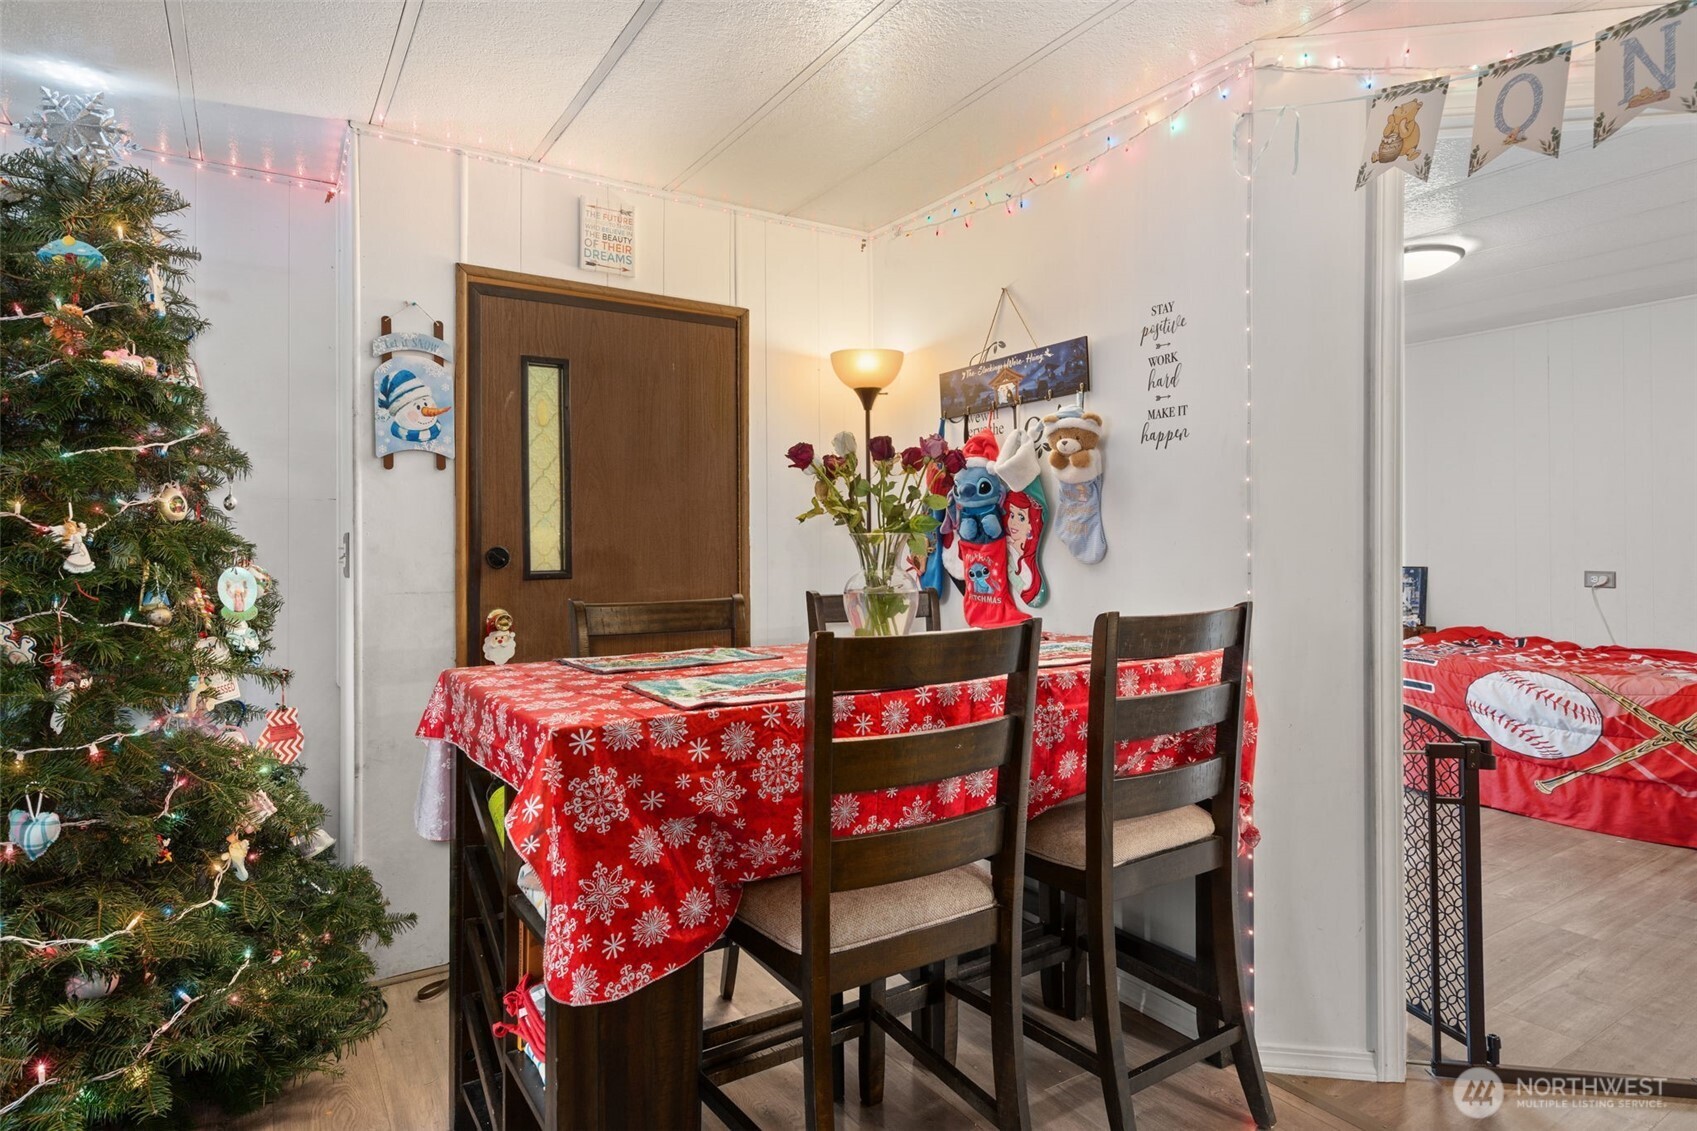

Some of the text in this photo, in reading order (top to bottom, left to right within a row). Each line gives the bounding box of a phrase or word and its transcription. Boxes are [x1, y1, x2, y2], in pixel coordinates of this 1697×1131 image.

[586, 210, 601, 220] THE
[602, 213, 633, 225] FUTURE
[585, 223, 600, 232] WHO
[585, 230, 633, 244] THE BEAUTY
[584, 238, 632, 254] OF THEIR
[584, 247, 632, 265] DREAMS
[1151, 301, 1175, 316] STAY
[1140, 314, 1187, 346] positive
[1148, 351, 1178, 367] WORK
[1148, 363, 1182, 391] hard
[1148, 405, 1188, 420] MAKE IT
[1141, 422, 1190, 450] happen
